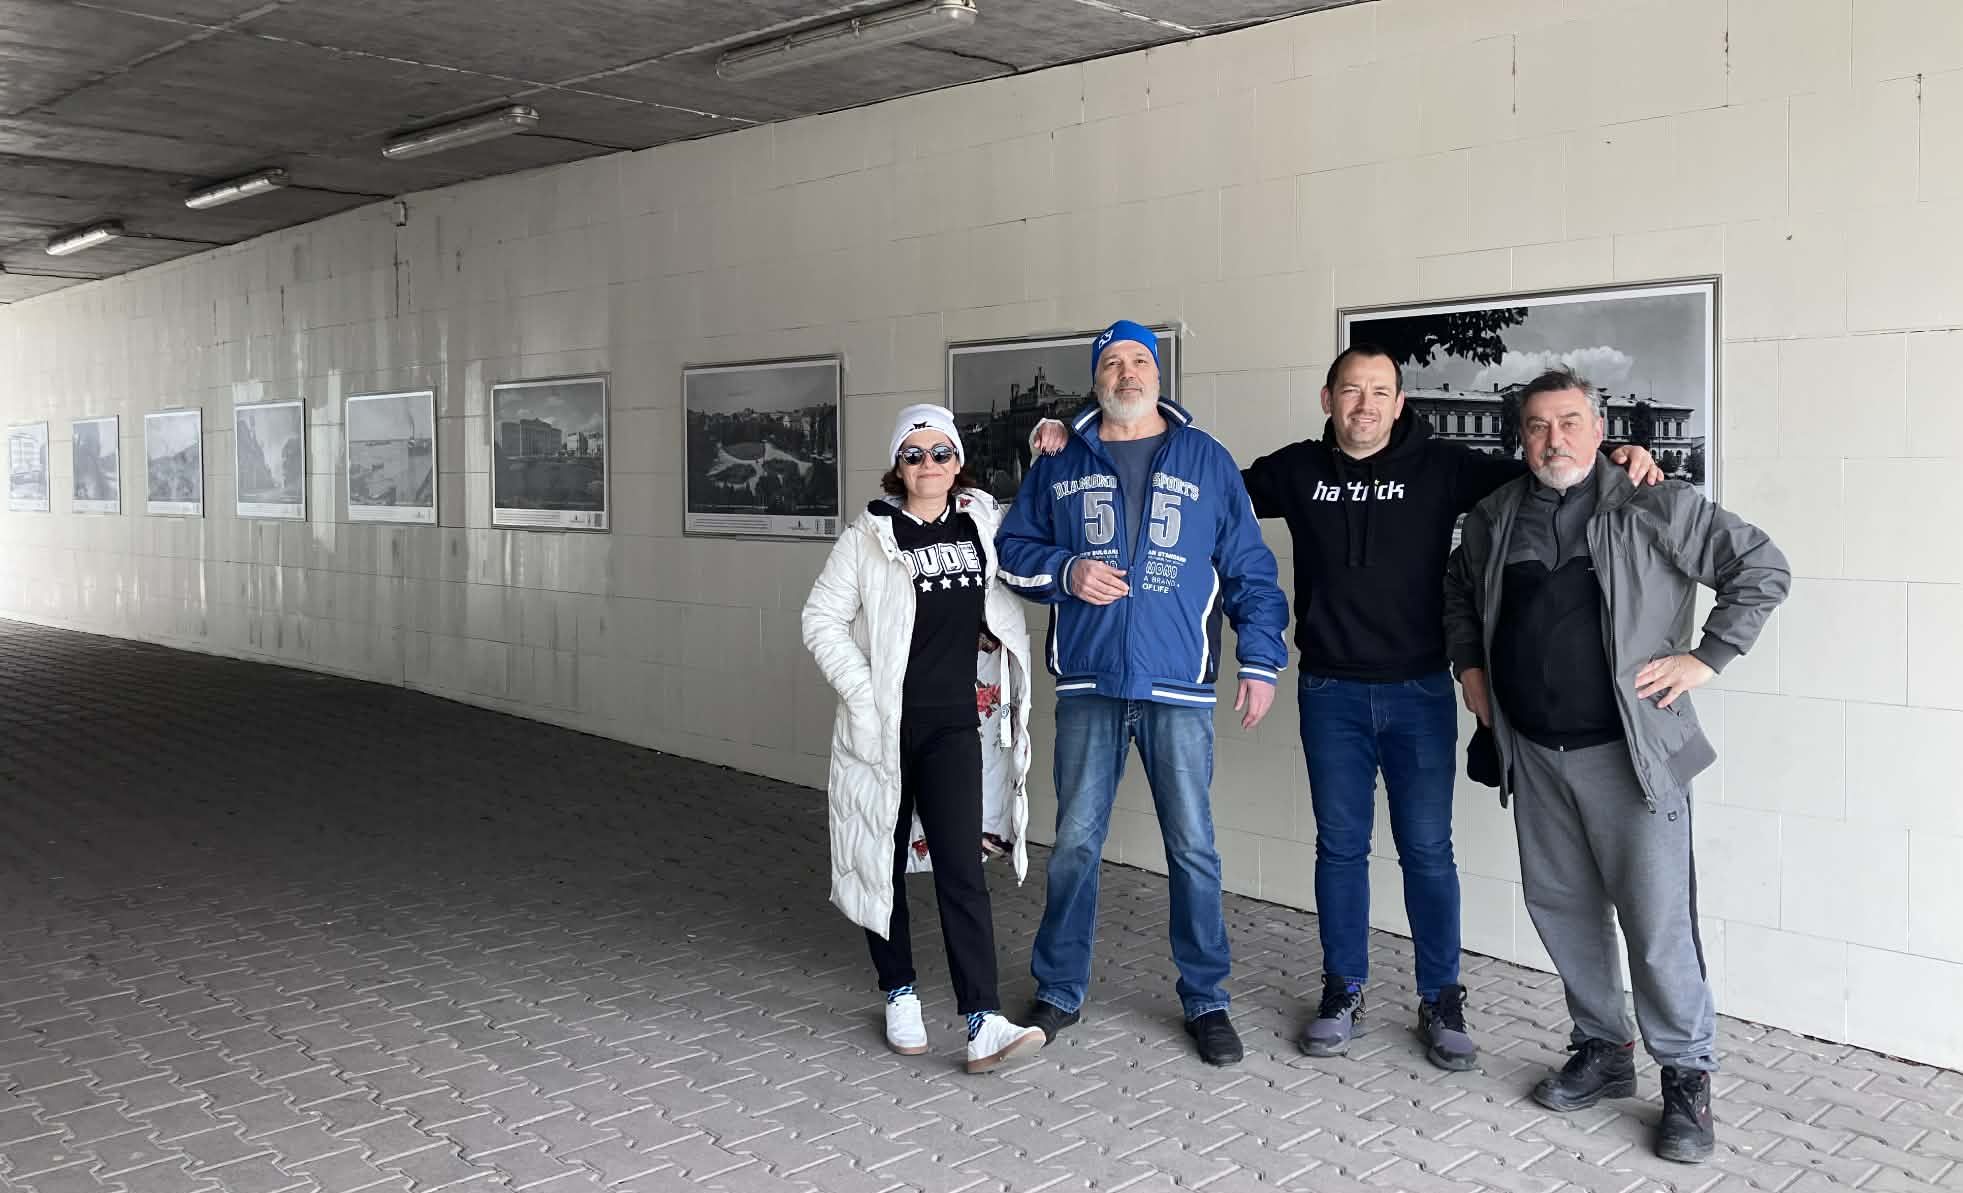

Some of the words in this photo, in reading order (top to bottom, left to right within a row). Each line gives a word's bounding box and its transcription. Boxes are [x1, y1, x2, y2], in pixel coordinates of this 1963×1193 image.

[1052, 474, 1118, 500] DIAMOND
[1152, 472, 1200, 501] SPORTS
[1312, 480, 1405, 502] hatrick
[1084, 491, 1115, 545] 5
[1150, 491, 1182, 548] 5
[1151, 576, 1176, 587] BRAND
[1153, 584, 1170, 594] LIFE
